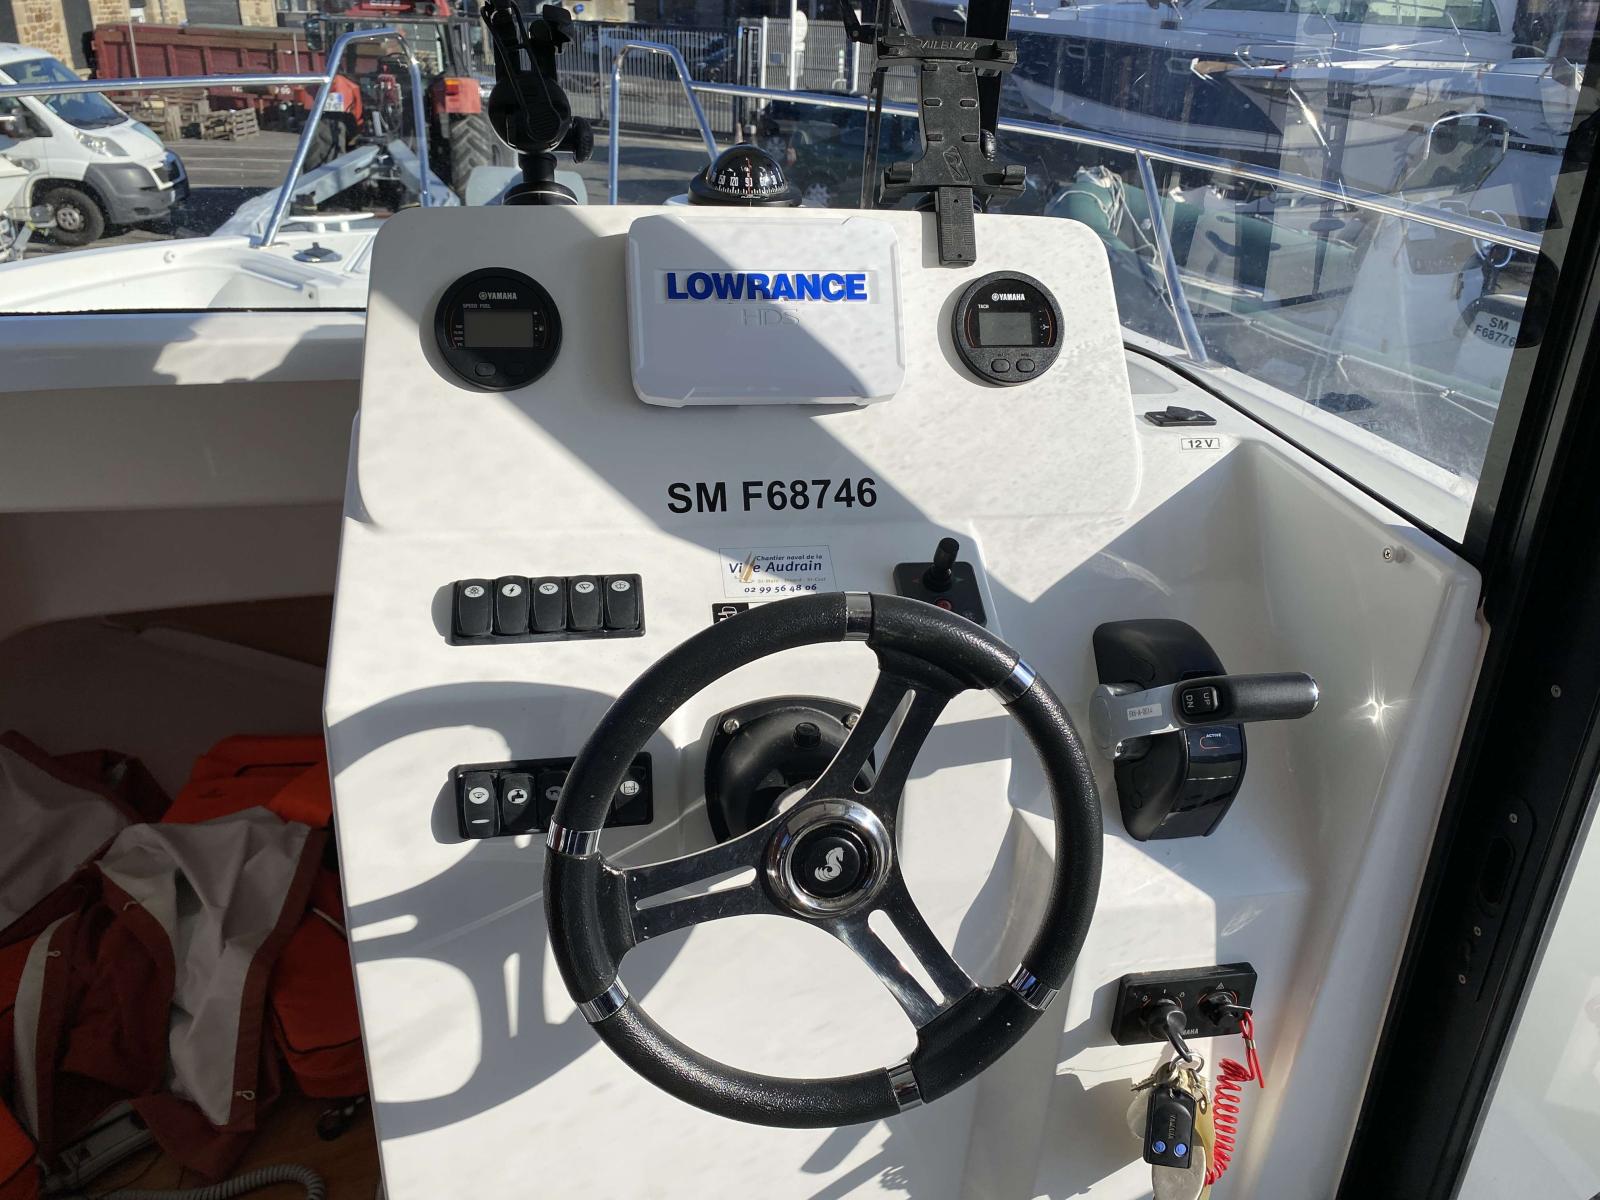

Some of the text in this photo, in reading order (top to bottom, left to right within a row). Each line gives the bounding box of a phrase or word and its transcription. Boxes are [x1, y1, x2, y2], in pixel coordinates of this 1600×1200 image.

[730, 176, 738, 187] 120
[667, 272, 868, 302] LOWRANCE
[487, 292, 517, 300] YAMAHA
[999, 293, 1026, 301] YAMAHA
[1489, 317, 1510, 332] SM
[1473, 325, 1517, 348] F68776
[1187, 439, 1213, 449] 12 V
[667, 477, 877, 514] SM F68746
[765, 560, 822, 573] Audrain
[775, 584, 787, 593] 56
[789, 584, 802, 593] 48
[805, 583, 817, 591] 06
[1185, 694, 1194, 708] DN
[1203, 691, 1211, 705] UP
